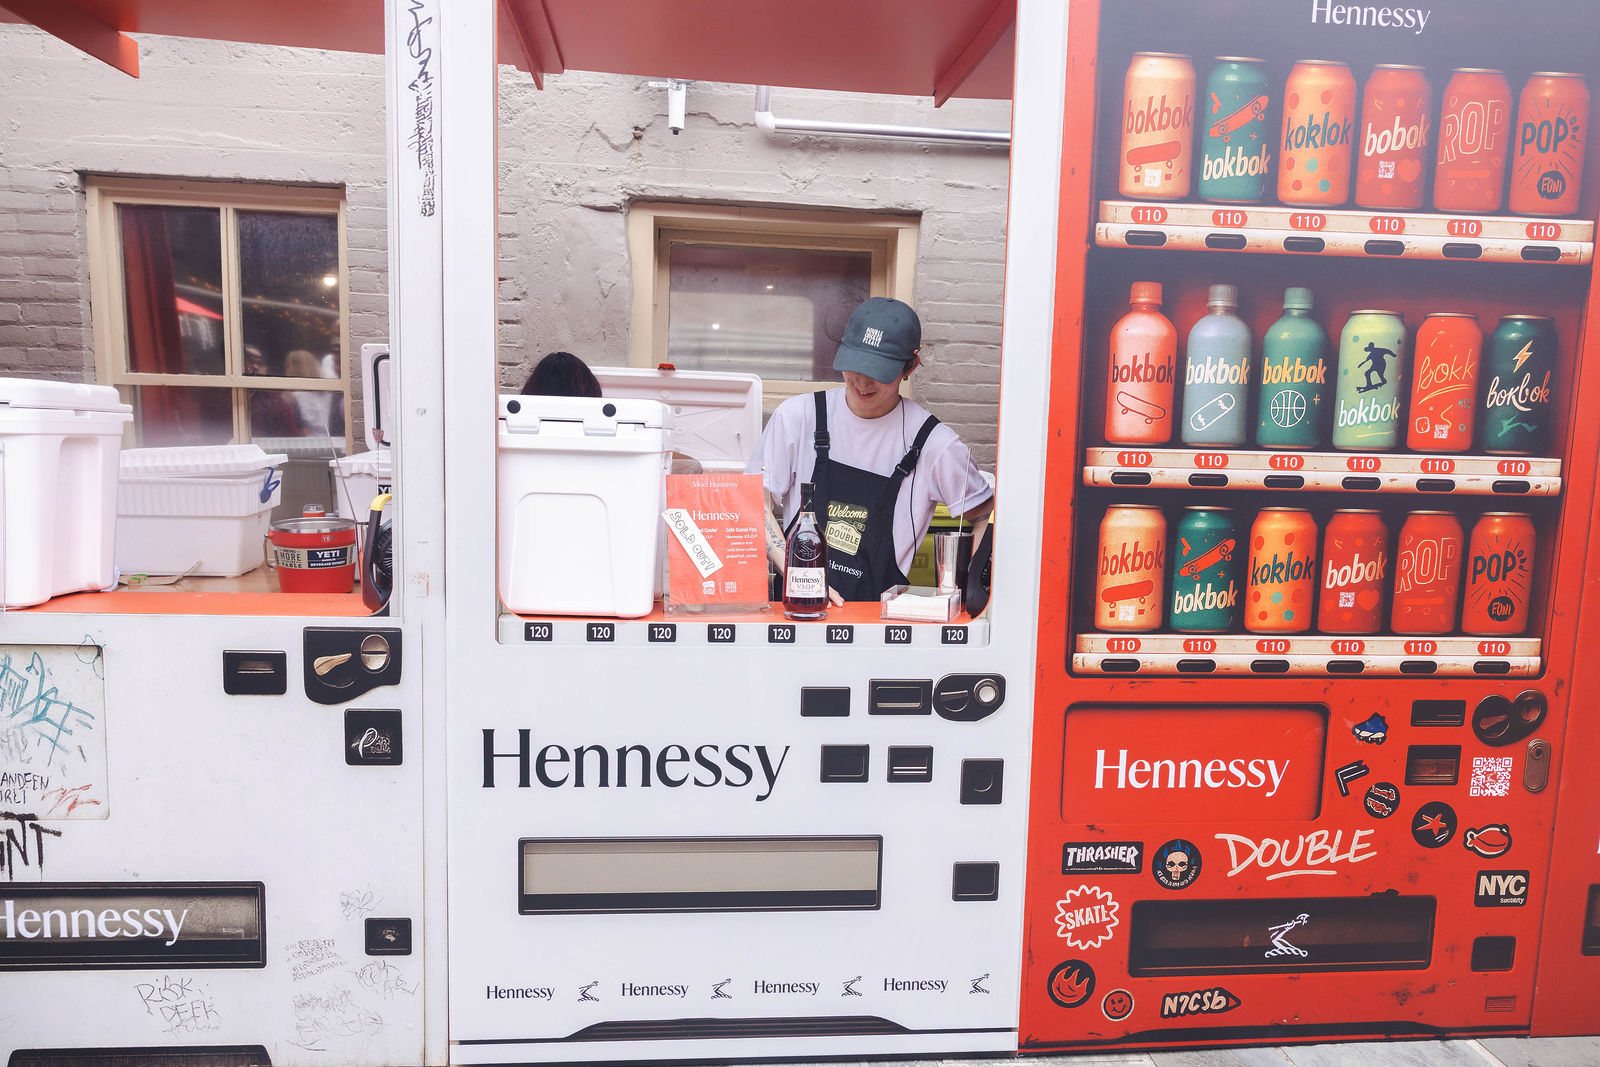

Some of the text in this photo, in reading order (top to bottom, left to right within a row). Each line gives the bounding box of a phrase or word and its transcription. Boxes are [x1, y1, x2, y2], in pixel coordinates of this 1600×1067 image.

[1312, 0, 1430, 34] Hennessy
[1126, 95, 1192, 134] bokbok
[1364, 114, 1430, 157] bobok
[1520, 117, 1569, 156] POP
[1202, 144, 1271, 181] bokbok
[1138, 209, 1162, 221] 110
[1218, 212, 1242, 224] 110
[1296, 215, 1320, 228] 110
[1375, 218, 1399, 231] 110
[1452, 222, 1477, 234] 110
[1531, 225, 1555, 237] 110
[1112, 352, 1173, 384] bokbok
[1185, 356, 1249, 385] bokbok
[1263, 356, 1327, 385] bokbok
[1338, 397, 1400, 427] bokbok
[1123, 453, 1147, 465] 110
[1199, 455, 1223, 466] 110
[1275, 456, 1298, 468] 110
[1352, 458, 1375, 470] 110
[1426, 460, 1450, 472] 110
[1502, 462, 1525, 473] 110
[692, 510, 740, 522] Hennessy
[828, 504, 868, 518] Welcome
[669, 511, 696, 544] SOLD
[692, 544, 716, 571] OUT!
[829, 527, 860, 546] DOUBLE
[280, 552, 301, 562] MORE
[316, 550, 340, 558] YETI
[1101, 540, 1163, 576] bokbok
[829, 560, 863, 578] Hennessy
[1326, 552, 1387, 590] bobok
[1472, 551, 1516, 585] POP
[791, 575, 820, 584] Hennessy
[1174, 579, 1238, 614] bokbok
[529, 626, 549, 638] 120
[592, 626, 610, 638] 120
[653, 627, 672, 639] 120
[713, 628, 731, 640] 120
[773, 628, 791, 640] 120
[831, 629, 849, 640] 120
[889, 629, 907, 641] 120
[946, 630, 964, 641] 120
[1112, 640, 1136, 651] 110
[1188, 641, 1212, 652] 110
[1262, 641, 1286, 653] 110
[1336, 641, 1359, 652] 110
[1409, 642, 1432, 653] 110
[1483, 643, 1505, 654] 110
[482, 728, 791, 801] Hennessy
[1094, 749, 1290, 797] Hennessy
[1067, 846, 1139, 867] THRASHER
[1214, 829, 1377, 878] DOUBLE
[1479, 875, 1526, 896] NYC
[621, 982, 689, 998] Hennessy
[754, 980, 820, 995] Hennessy
[884, 978, 949, 993] Hennessy
[486, 985, 555, 1001] Hennessy
